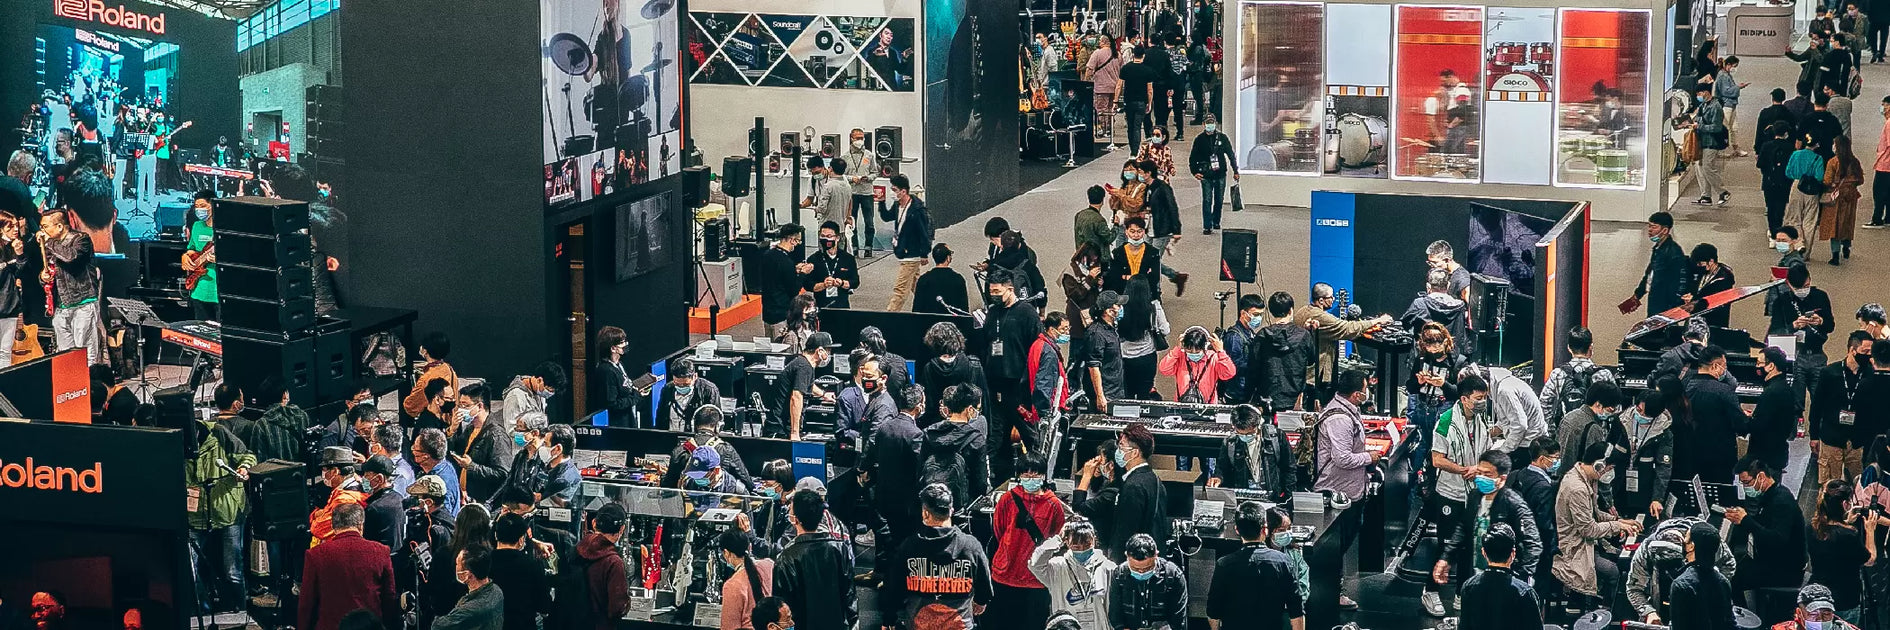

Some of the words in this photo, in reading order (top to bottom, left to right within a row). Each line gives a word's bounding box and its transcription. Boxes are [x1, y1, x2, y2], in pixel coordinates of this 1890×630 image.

[88, 0, 165, 34] Roland
[1740, 29, 1777, 37] MIDIPLUS
[65, 386, 88, 401] Roland
[1406, 517, 1427, 549] Roland
[907, 557, 972, 580] SILENCE
[907, 576, 919, 592] NO
